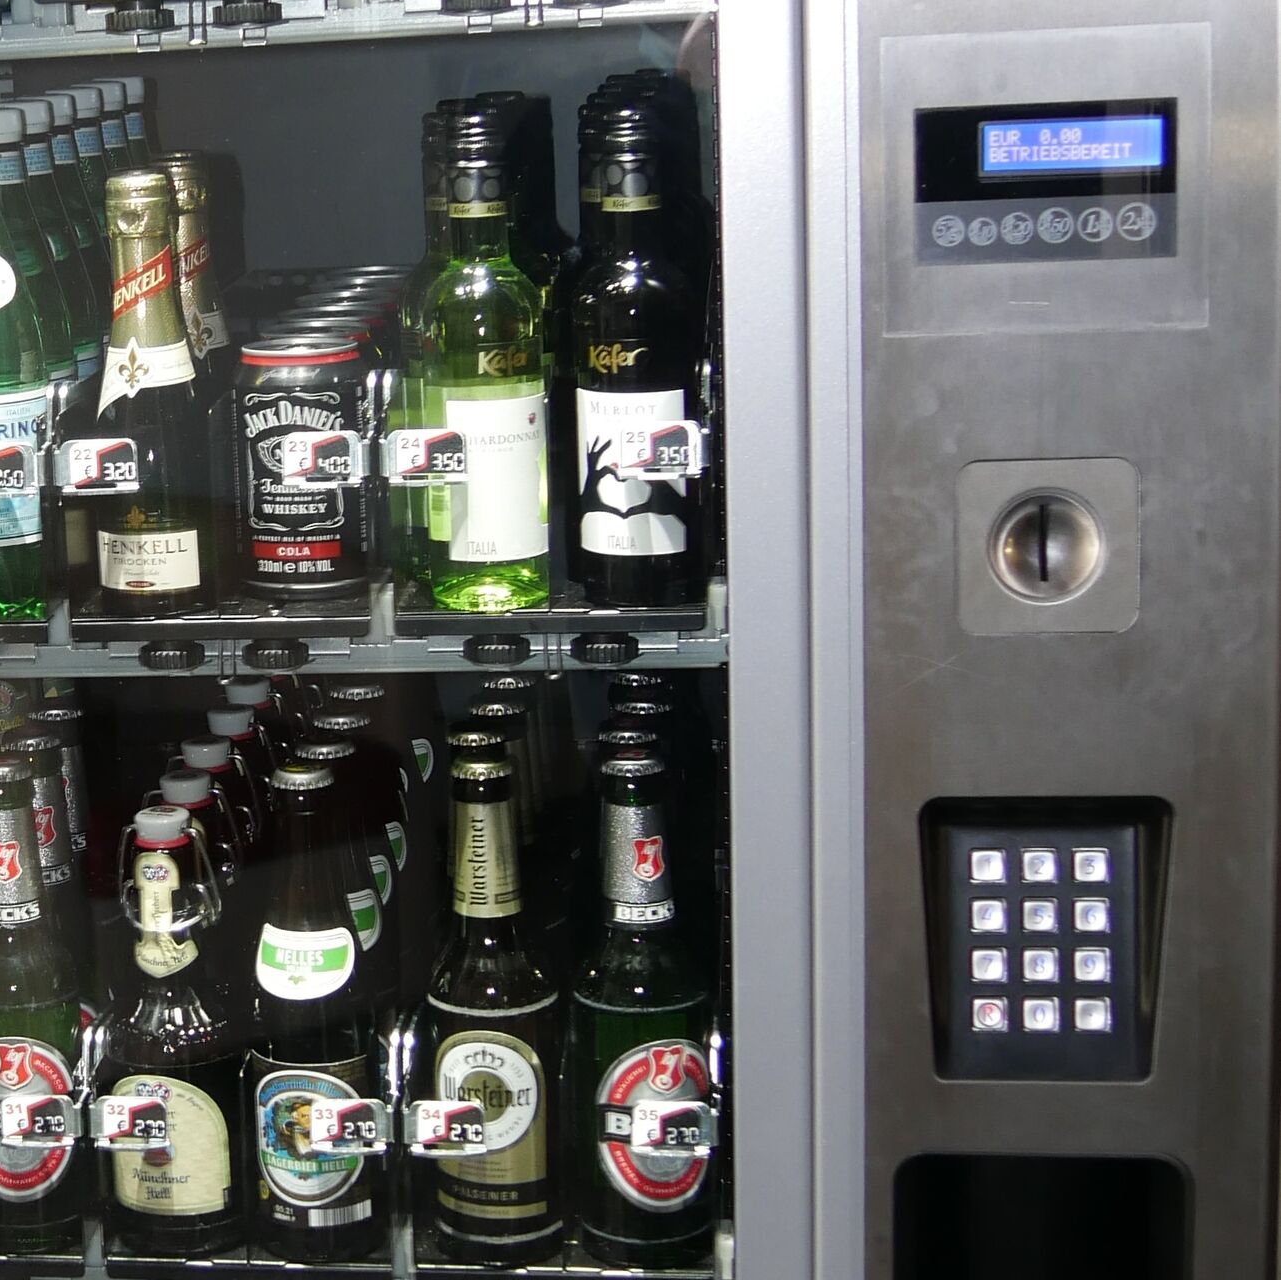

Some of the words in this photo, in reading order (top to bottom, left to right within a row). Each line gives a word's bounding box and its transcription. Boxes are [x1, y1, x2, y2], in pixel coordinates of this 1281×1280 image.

[989, 131, 1021, 146] EUR
[1039, 128, 1082, 144] 0.00
[989, 143, 1132, 163] BETRIEBSBEREIT
[590, 343, 649, 374] Käfer
[590, 401, 656, 416] MERLOT
[243, 406, 278, 438] JACK
[401, 437, 420, 449] 24
[468, 430, 541, 446] HARDONNAY
[626, 431, 646, 443] 25
[74, 449, 92, 460] 22
[288, 441, 307, 452] 23
[261, 503, 327, 515] WHISKEY
[103, 537, 188, 554] HENKELL
[468, 541, 497, 555] ITALIA
[608, 536, 637, 549] ITALIA
[277, 546, 311, 556] COLA
[113, 557, 167, 565] TROCKEN
[468, 816, 488, 906] Warsteiner
[1034, 858, 1044, 874] 2
[1084, 858, 1095, 875] 3
[982, 906, 993, 920] 4
[1034, 907, 1044, 924] 5
[1086, 908, 1097, 924] 6
[982, 957, 994, 974] 7
[1034, 958, 1045, 974] 8
[1084, 957, 1096, 974] 9
[982, 1006, 994, 1022] R
[1034, 1006, 1045, 1022] 0
[444, 1072, 532, 1108] Warsteiner
[5, 1104, 22, 1114] 31
[107, 1105, 125, 1115] 32
[315, 1109, 334, 1119] 33
[422, 1109, 441, 1120] 34
[638, 1109, 658, 1120] 35
